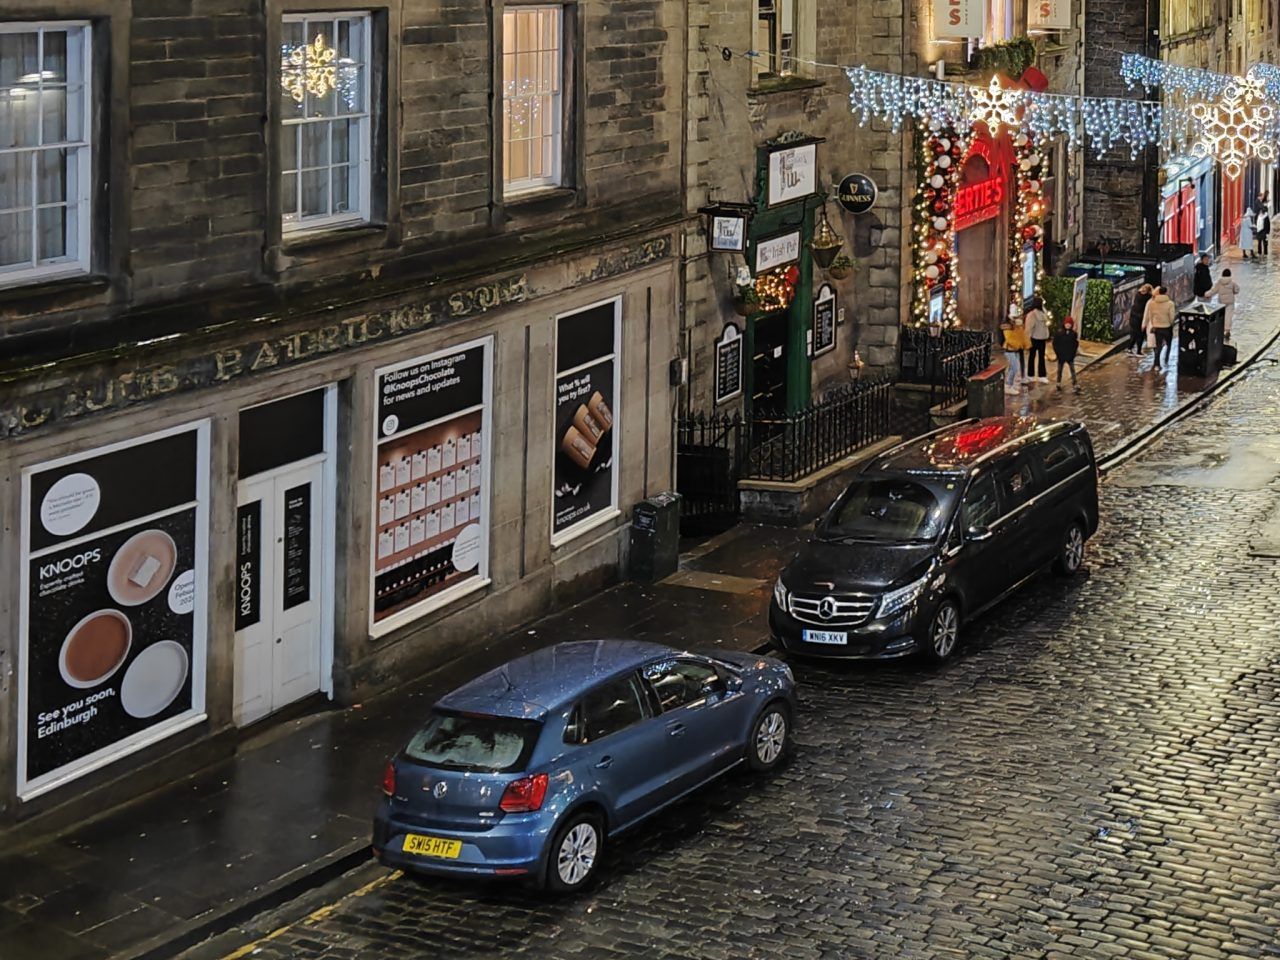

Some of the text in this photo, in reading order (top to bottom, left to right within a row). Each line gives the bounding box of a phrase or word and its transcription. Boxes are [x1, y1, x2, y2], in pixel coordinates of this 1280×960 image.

[840, 193, 872, 203] GUINNESS
[953, 177, 1002, 216] ERTIE'S
[383, 367, 455, 395] @KnoopsChocolate
[384, 354, 466, 383] Follow us on Instagram
[383, 376, 461, 406] for news and updates
[558, 394, 569, 406] you
[559, 381, 574, 393] What
[39, 548, 101, 580] KNOOPS
[241, 562, 251, 616] KNOOPS
[828, 632, 845, 643] XKV
[37, 688, 115, 725] See you soon,
[37, 706, 97, 739] Edinburgh
[409, 837, 453, 855] SW15 HTF
